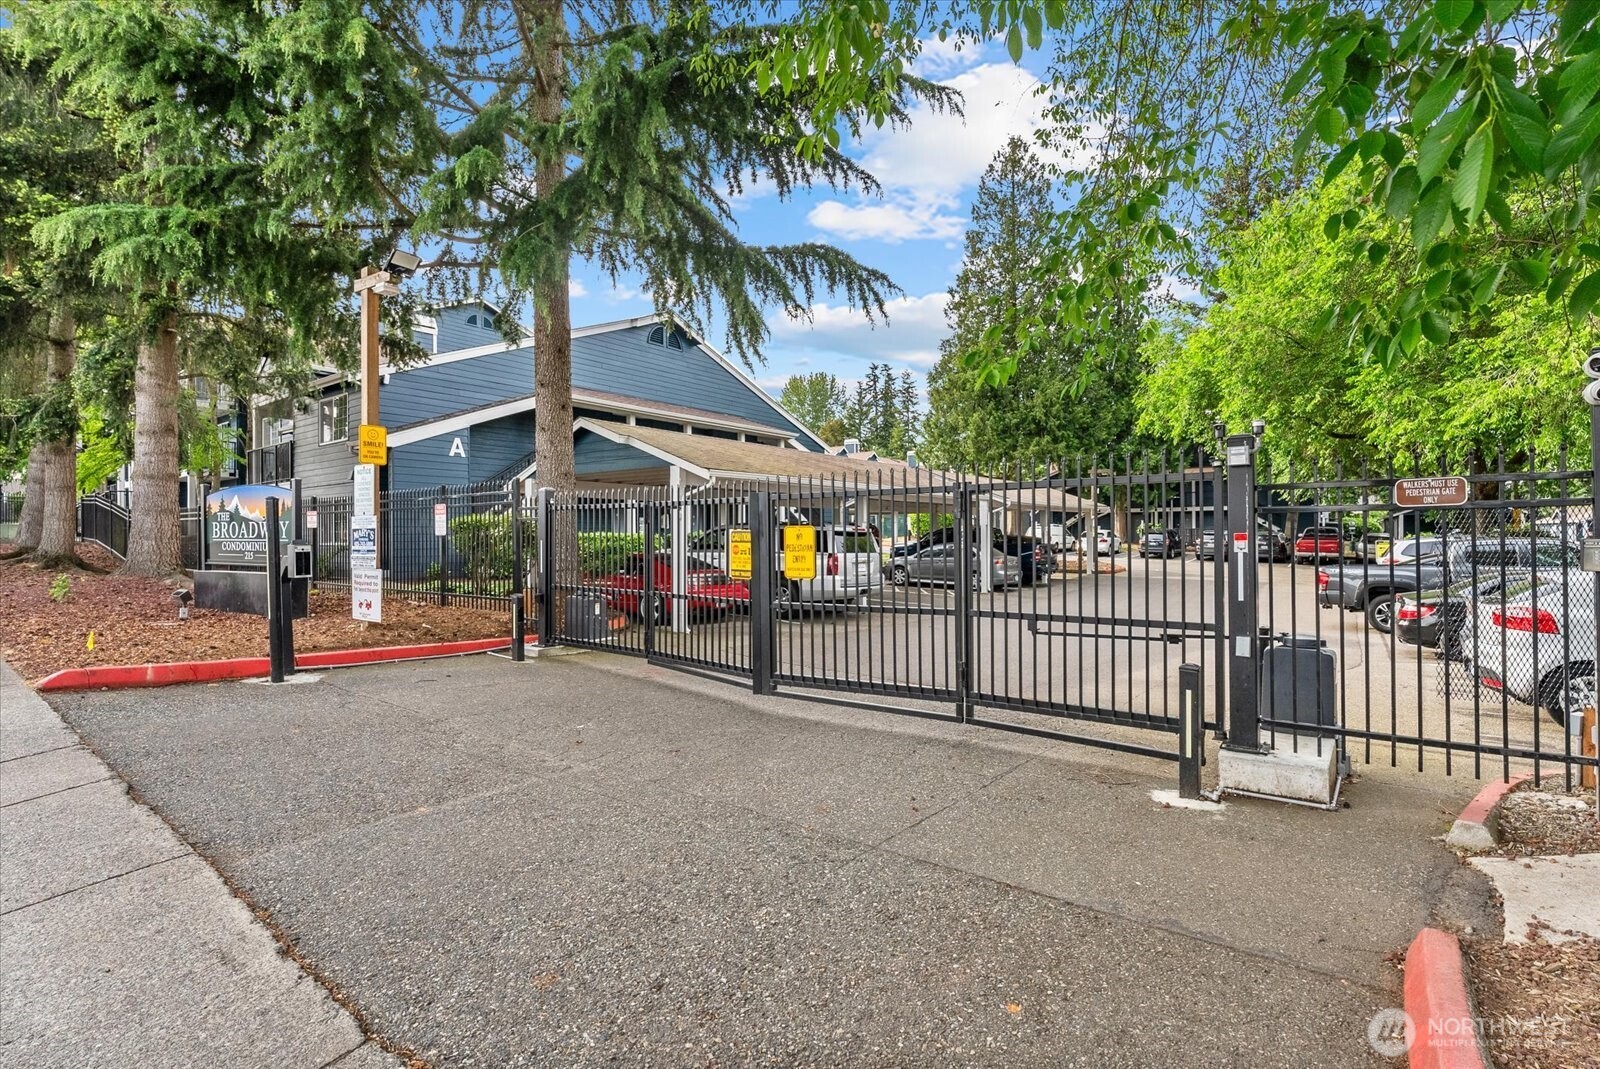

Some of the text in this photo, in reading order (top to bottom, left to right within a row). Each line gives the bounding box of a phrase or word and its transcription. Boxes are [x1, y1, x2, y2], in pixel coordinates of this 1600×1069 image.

[362, 440, 384, 448] SMILE!
[448, 438, 466, 458] A
[1406, 487, 1456, 496] PEDESTRIAN GATE
[217, 512, 230, 521] THE
[212, 520, 290, 538] BROADWY
[354, 528, 374, 540] MARY'S
[222, 541, 268, 552] CONDOMINIU
[244, 552, 254, 560] 215
